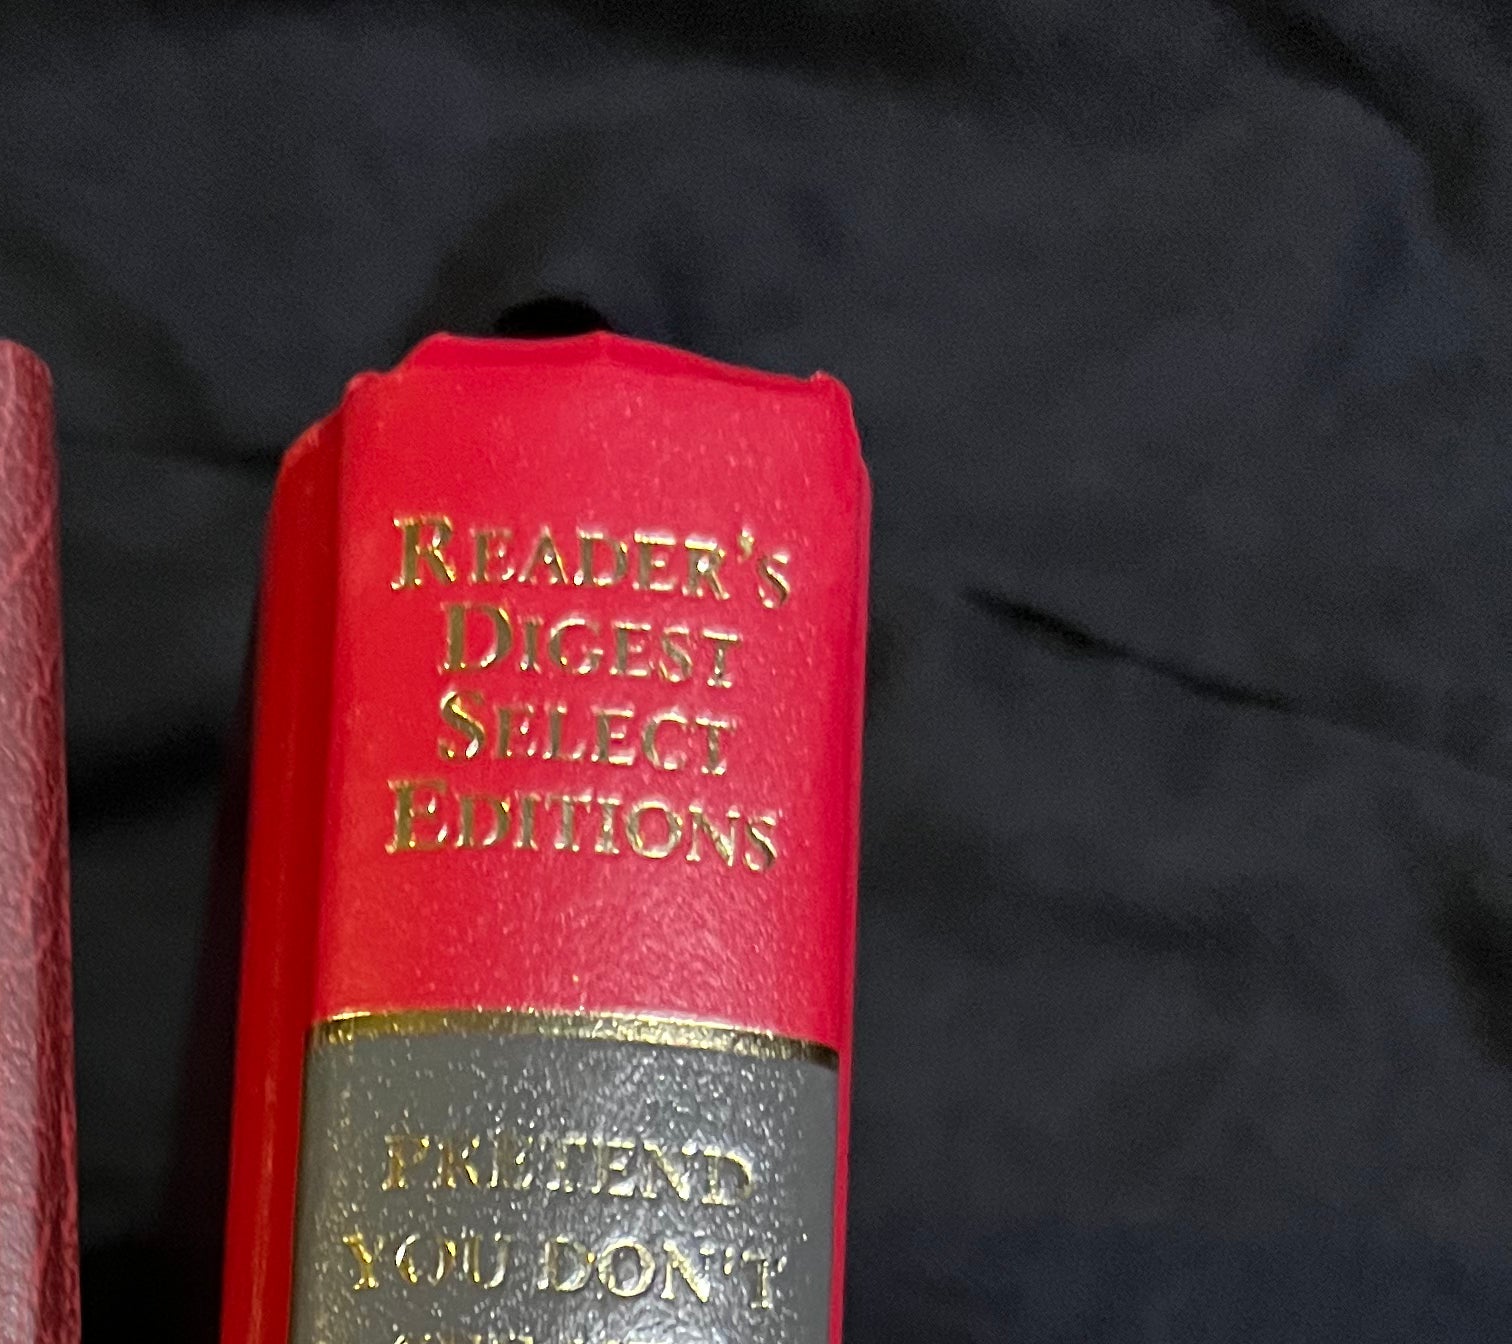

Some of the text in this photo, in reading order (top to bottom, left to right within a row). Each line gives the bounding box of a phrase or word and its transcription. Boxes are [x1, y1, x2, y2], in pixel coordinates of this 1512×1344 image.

[390, 513, 791, 609] READER'S
[436, 598, 741, 689] DIGEST
[436, 688, 738, 776] SELECT
[384, 777, 784, 873] EDITIONS
[342, 1230, 510, 1291] YOU
